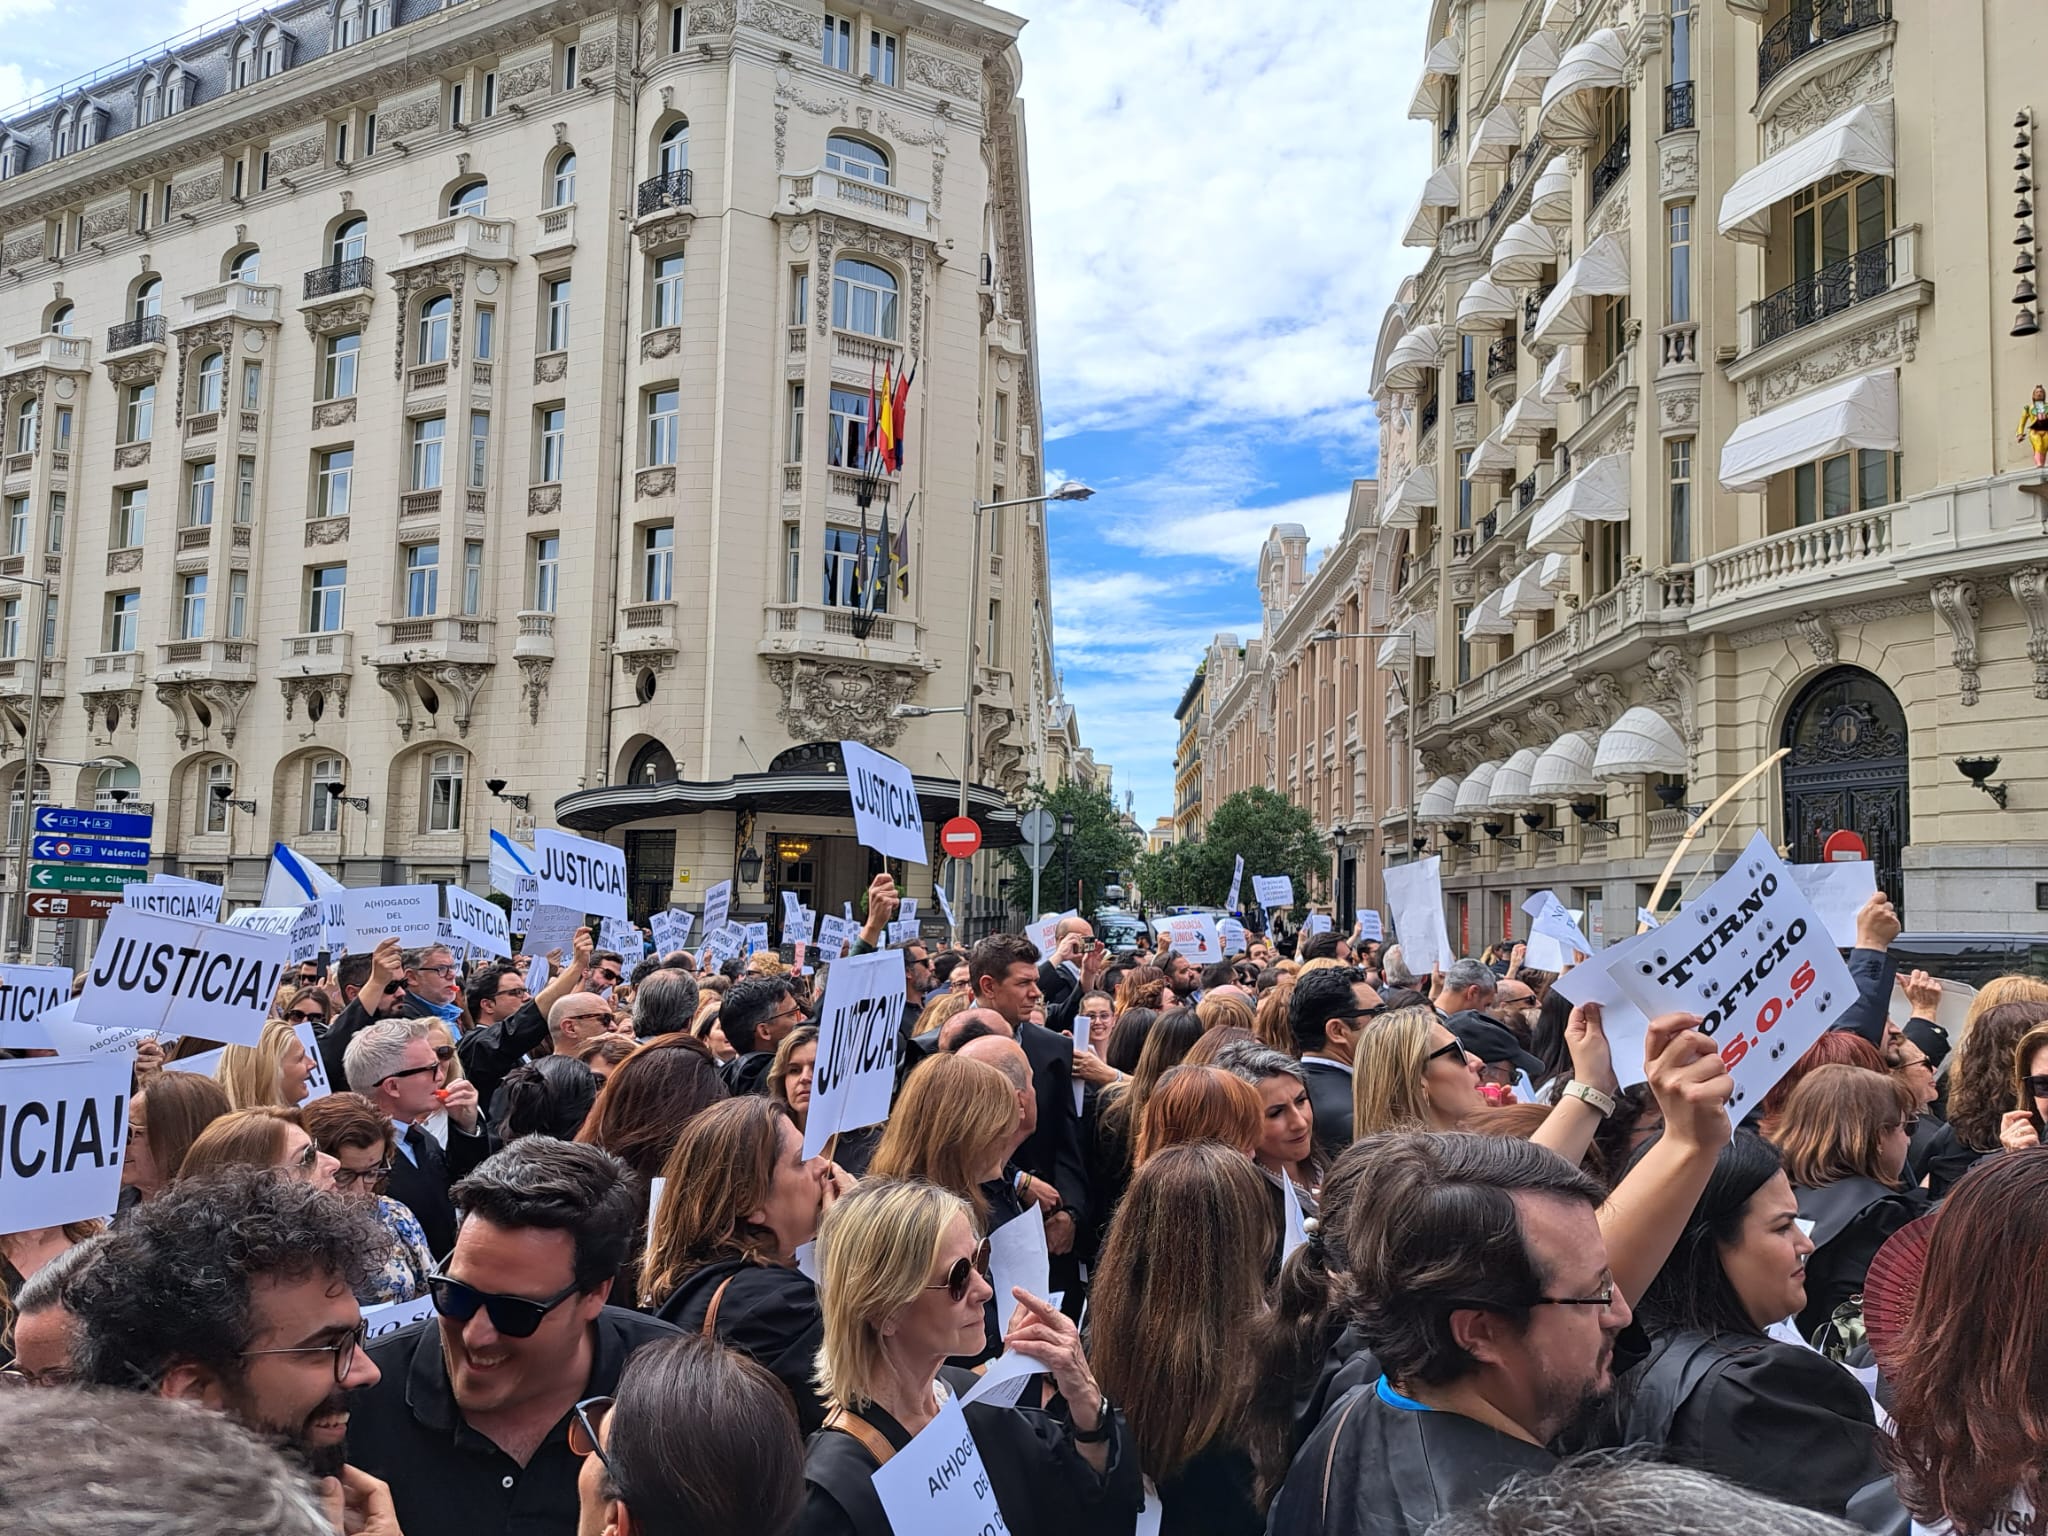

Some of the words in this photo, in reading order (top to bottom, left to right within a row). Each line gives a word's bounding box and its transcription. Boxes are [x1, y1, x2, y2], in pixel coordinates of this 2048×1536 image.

[856, 766, 922, 833] JUSTICIA!
[100, 847, 147, 858] Valencia
[540, 847, 627, 898] JUSTICIA!
[364, 897, 421, 909] A(H)OGADOS
[386, 912, 402, 920] DEL
[452, 897, 510, 942] JUSTICIA!
[356, 926, 389, 936] TURNO
[391, 925, 402, 934] DE
[404, 923, 430, 933] OFICIO
[1656, 872, 1779, 990] TURNO
[1740, 949, 1749, 958] DE
[93, 937, 280, 1011] JUSTICIA!
[1697, 917, 1808, 1037] OFICIO
[1721, 959, 1817, 1073] S.O.S
